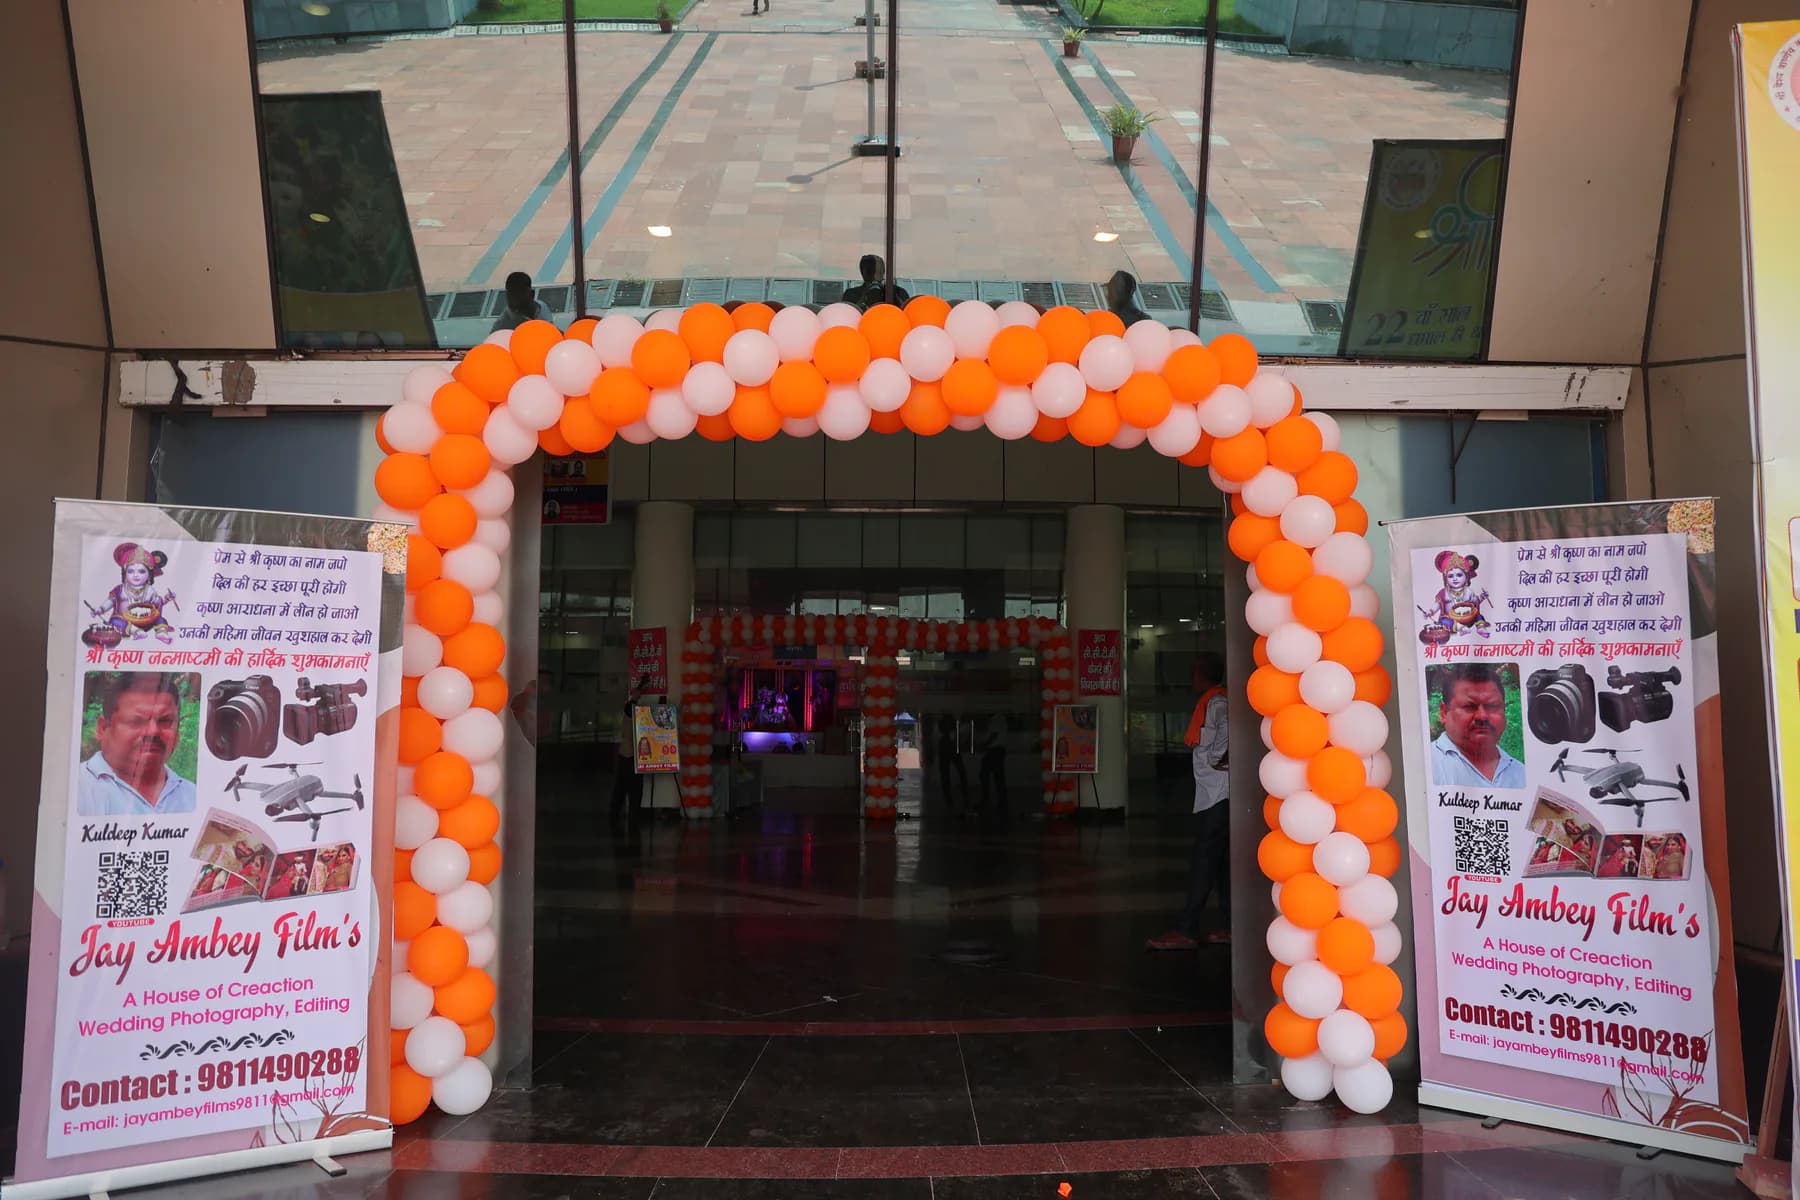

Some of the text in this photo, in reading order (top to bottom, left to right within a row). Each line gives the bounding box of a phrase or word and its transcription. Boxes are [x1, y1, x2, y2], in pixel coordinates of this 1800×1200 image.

[1364, 308, 1408, 346] 22
[213, 548, 348, 571] प्रेम से श्री कृष्ण का नाम जपो
[1517, 541, 1647, 563] प्रेम से श्री कृष्ण का नाम जपो
[212, 573, 347, 597] दिल की हर इच्छा पूरी होगी
[1519, 565, 1649, 586] दिल की हर इच्छा पूरी होगी
[196, 600, 359, 620] कृष्ण आराधना में लीन हो जाओ
[1507, 590, 1665, 612] कृष्ण आराधना में लीन हो जाओ
[179, 624, 373, 646] उनकी महिमा जीवन खुशहाल कर देगी
[1495, 615, 1682, 635] उनकी महिमा जीवन खुशहाल कर देगी
[86, 645, 372, 672] श्री कृष्ण जन्माष्टमी की हार्दिक शुभकामनाएँ
[1424, 638, 1684, 662] श्री कृष्ण जन्माष्टमी की हार्दिक शुभकामनाएँ
[1438, 791, 1523, 815] Kuldeep Kumar
[80, 822, 190, 847] Kuldeep Kumar
[1441, 875, 1700, 942] Jay Ambey Film's
[112, 918, 150, 928] YOUTUBE
[69, 910, 361, 985] Jay Ambey Film's
[1483, 936, 1653, 970] A House of Creaction
[1452, 952, 1693, 1001] Wedding Photography, Editing
[122, 978, 314, 1008] A House of Creaction
[78, 996, 350, 1037] Wedding Photography, Editing
[1445, 997, 1534, 1034] Contact
[1550, 1013, 1707, 1063] 9811490288
[1449, 1029, 1705, 1084] E-mail: jayambeyfilms9811@gmail.com
[61, 1069, 178, 1111] Contact
[197, 1046, 360, 1092] 9811490288
[63, 1084, 354, 1135] E-mail: jayambeyfilms9811@gmail.com
